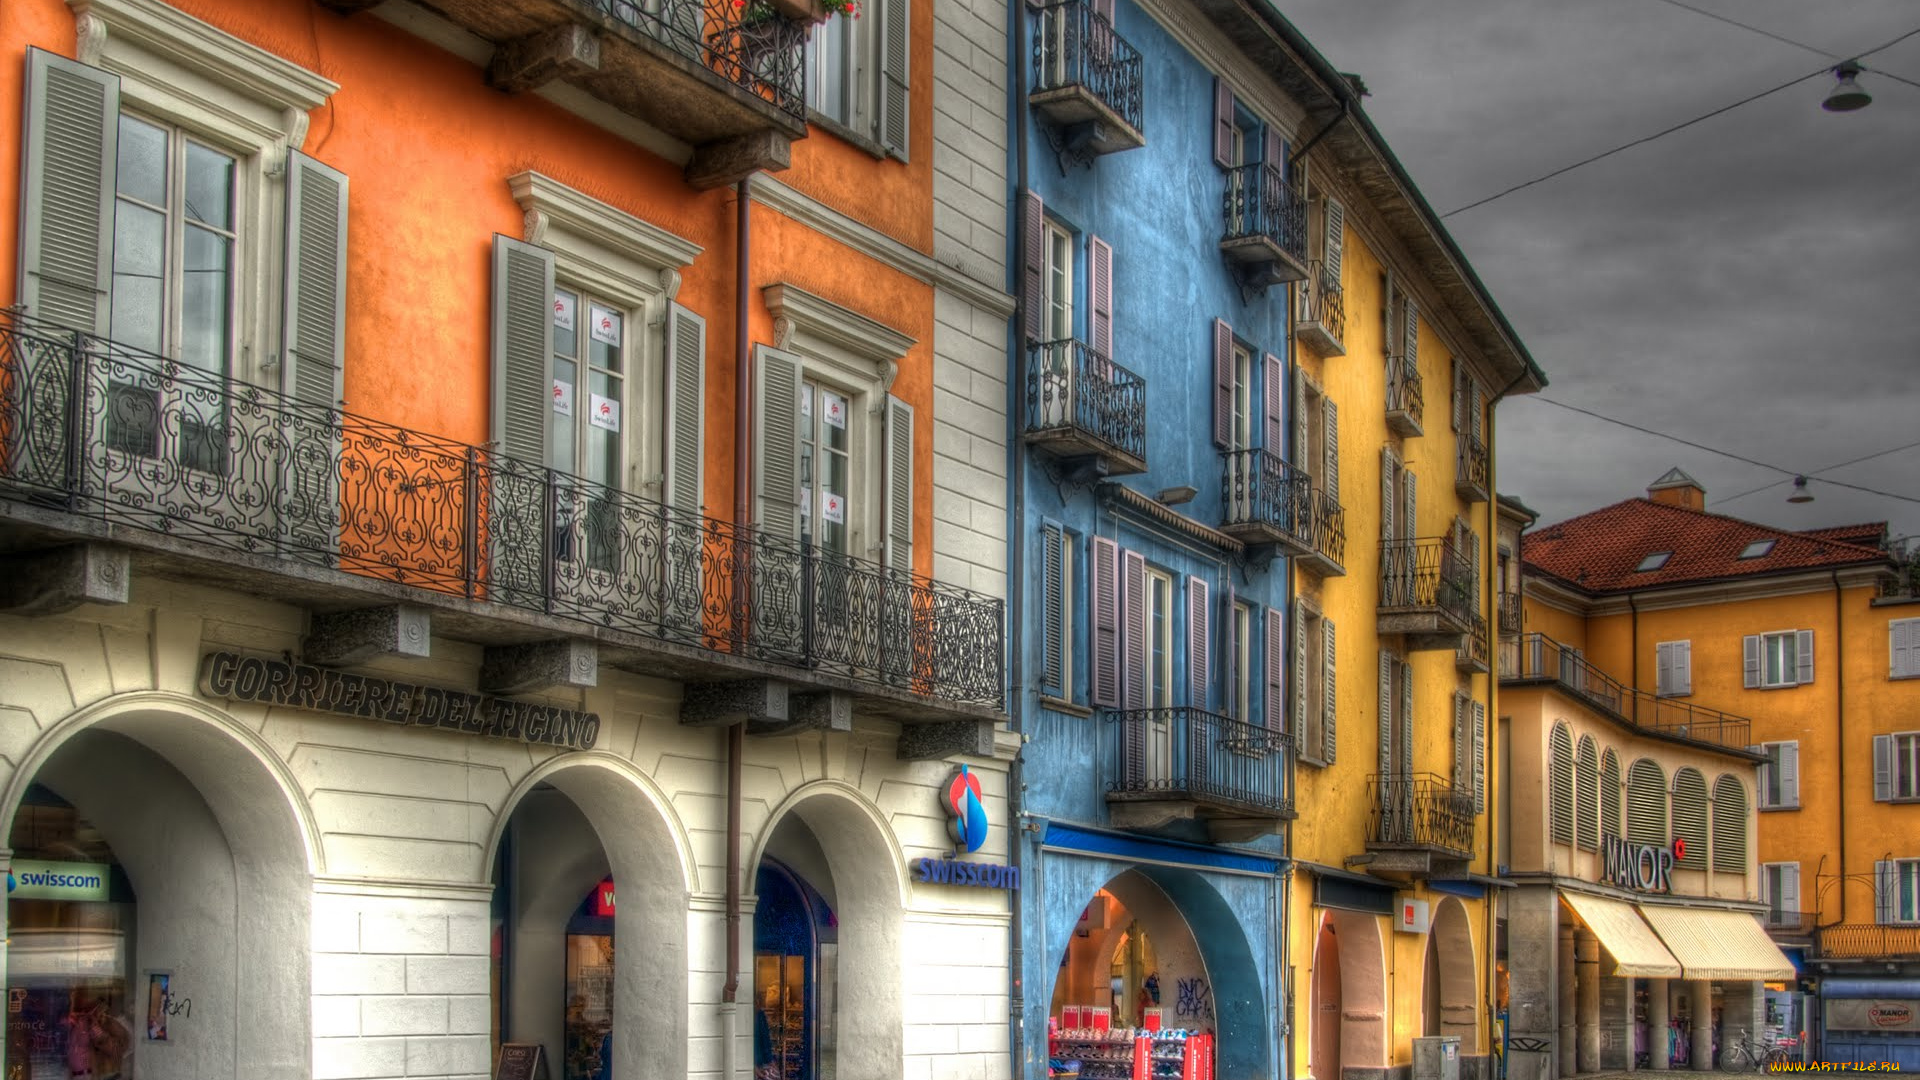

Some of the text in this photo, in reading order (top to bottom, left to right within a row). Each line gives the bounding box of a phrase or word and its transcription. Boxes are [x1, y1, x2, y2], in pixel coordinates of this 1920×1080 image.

[208, 651, 601, 751] CORRIERE DEL TICINO
[20, 869, 101, 889] swisscom
[918, 850, 1020, 890] swisscom
[1603, 833, 1674, 895] MANOR
[1879, 1009, 1909, 1017] MANOR
